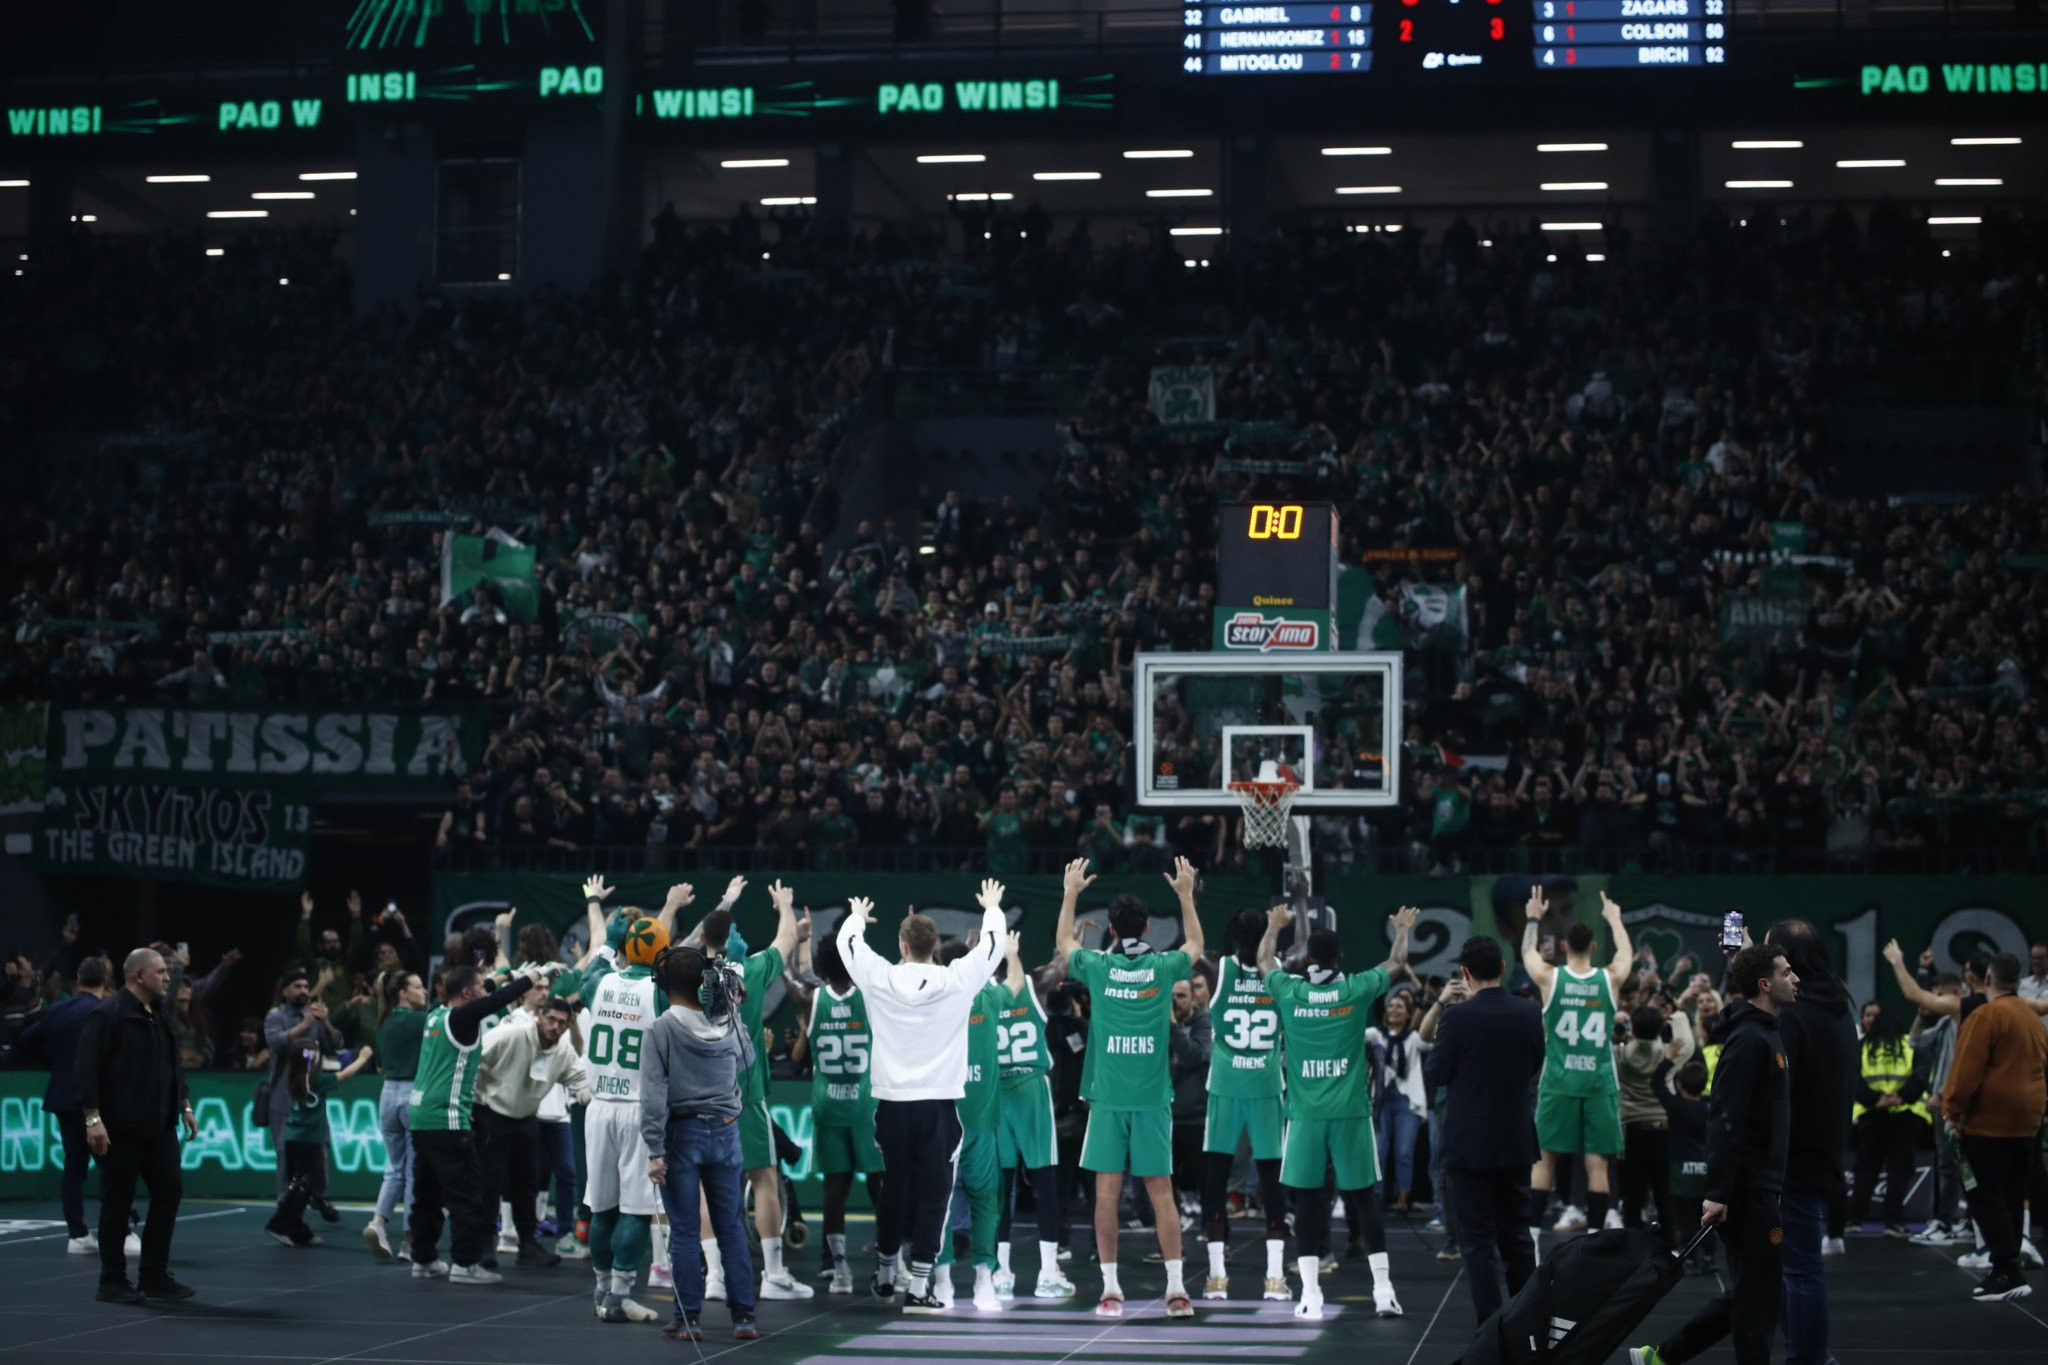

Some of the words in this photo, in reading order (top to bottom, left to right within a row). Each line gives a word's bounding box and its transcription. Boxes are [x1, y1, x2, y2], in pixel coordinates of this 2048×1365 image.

[1184, 9, 1203, 26] 32
[1219, 7, 1290, 24] GABRIEL
[1330, 6, 1341, 21] 4
[1543, 1, 1554, 18] 3
[1705, 0, 1724, 15] 32
[1184, 33, 1201, 49] 41
[1220, 29, 1325, 48] HERNANGOMEZ
[1330, 30, 1340, 45] 1
[1399, 18, 1414, 43] 2
[1489, 16, 1505, 41] 3
[1566, 25, 1575, 41] 1
[1621, 23, 1689, 40] COLSON
[1184, 56, 1203, 73] 44
[1220, 53, 1303, 71] MITOGLOU
[1330, 53, 1341, 69] 2
[1350, 52, 1362, 70] 7
[1543, 49, 1555, 65] 4
[1566, 49, 1576, 65] 3
[1638, 46, 1689, 63] BIRCH
[1705, 46, 1725, 63] 92
[540, 66, 603, 96] PAO
[1861, 64, 1929, 95] PAO
[878, 84, 944, 113] PAO
[219, 102, 280, 130] PAO
[61, 708, 468, 776] PATISSIA
[73, 784, 271, 847] SKYROS
[283, 804, 310, 832] 13
[44, 828, 95, 863] THE
[106, 832, 196, 870] GREEN
[210, 839, 305, 880] ISLAND
[618, 991, 641, 1007] GREEN
[1104, 983, 1160, 1000] instacar
[1308, 990, 1339, 1004] BROWN
[598, 1007, 643, 1021] instacar
[1294, 1005, 1355, 1018] instacar
[1223, 1009, 1278, 1050] 32
[1554, 1010, 1607, 1048] 44
[588, 1023, 644, 1071] 08
[816, 1034, 869, 1075] 25
[1106, 1035, 1156, 1054] ATHENS
[1302, 1058, 1349, 1079] ATHENS
[595, 1075, 630, 1096] ATHENS
